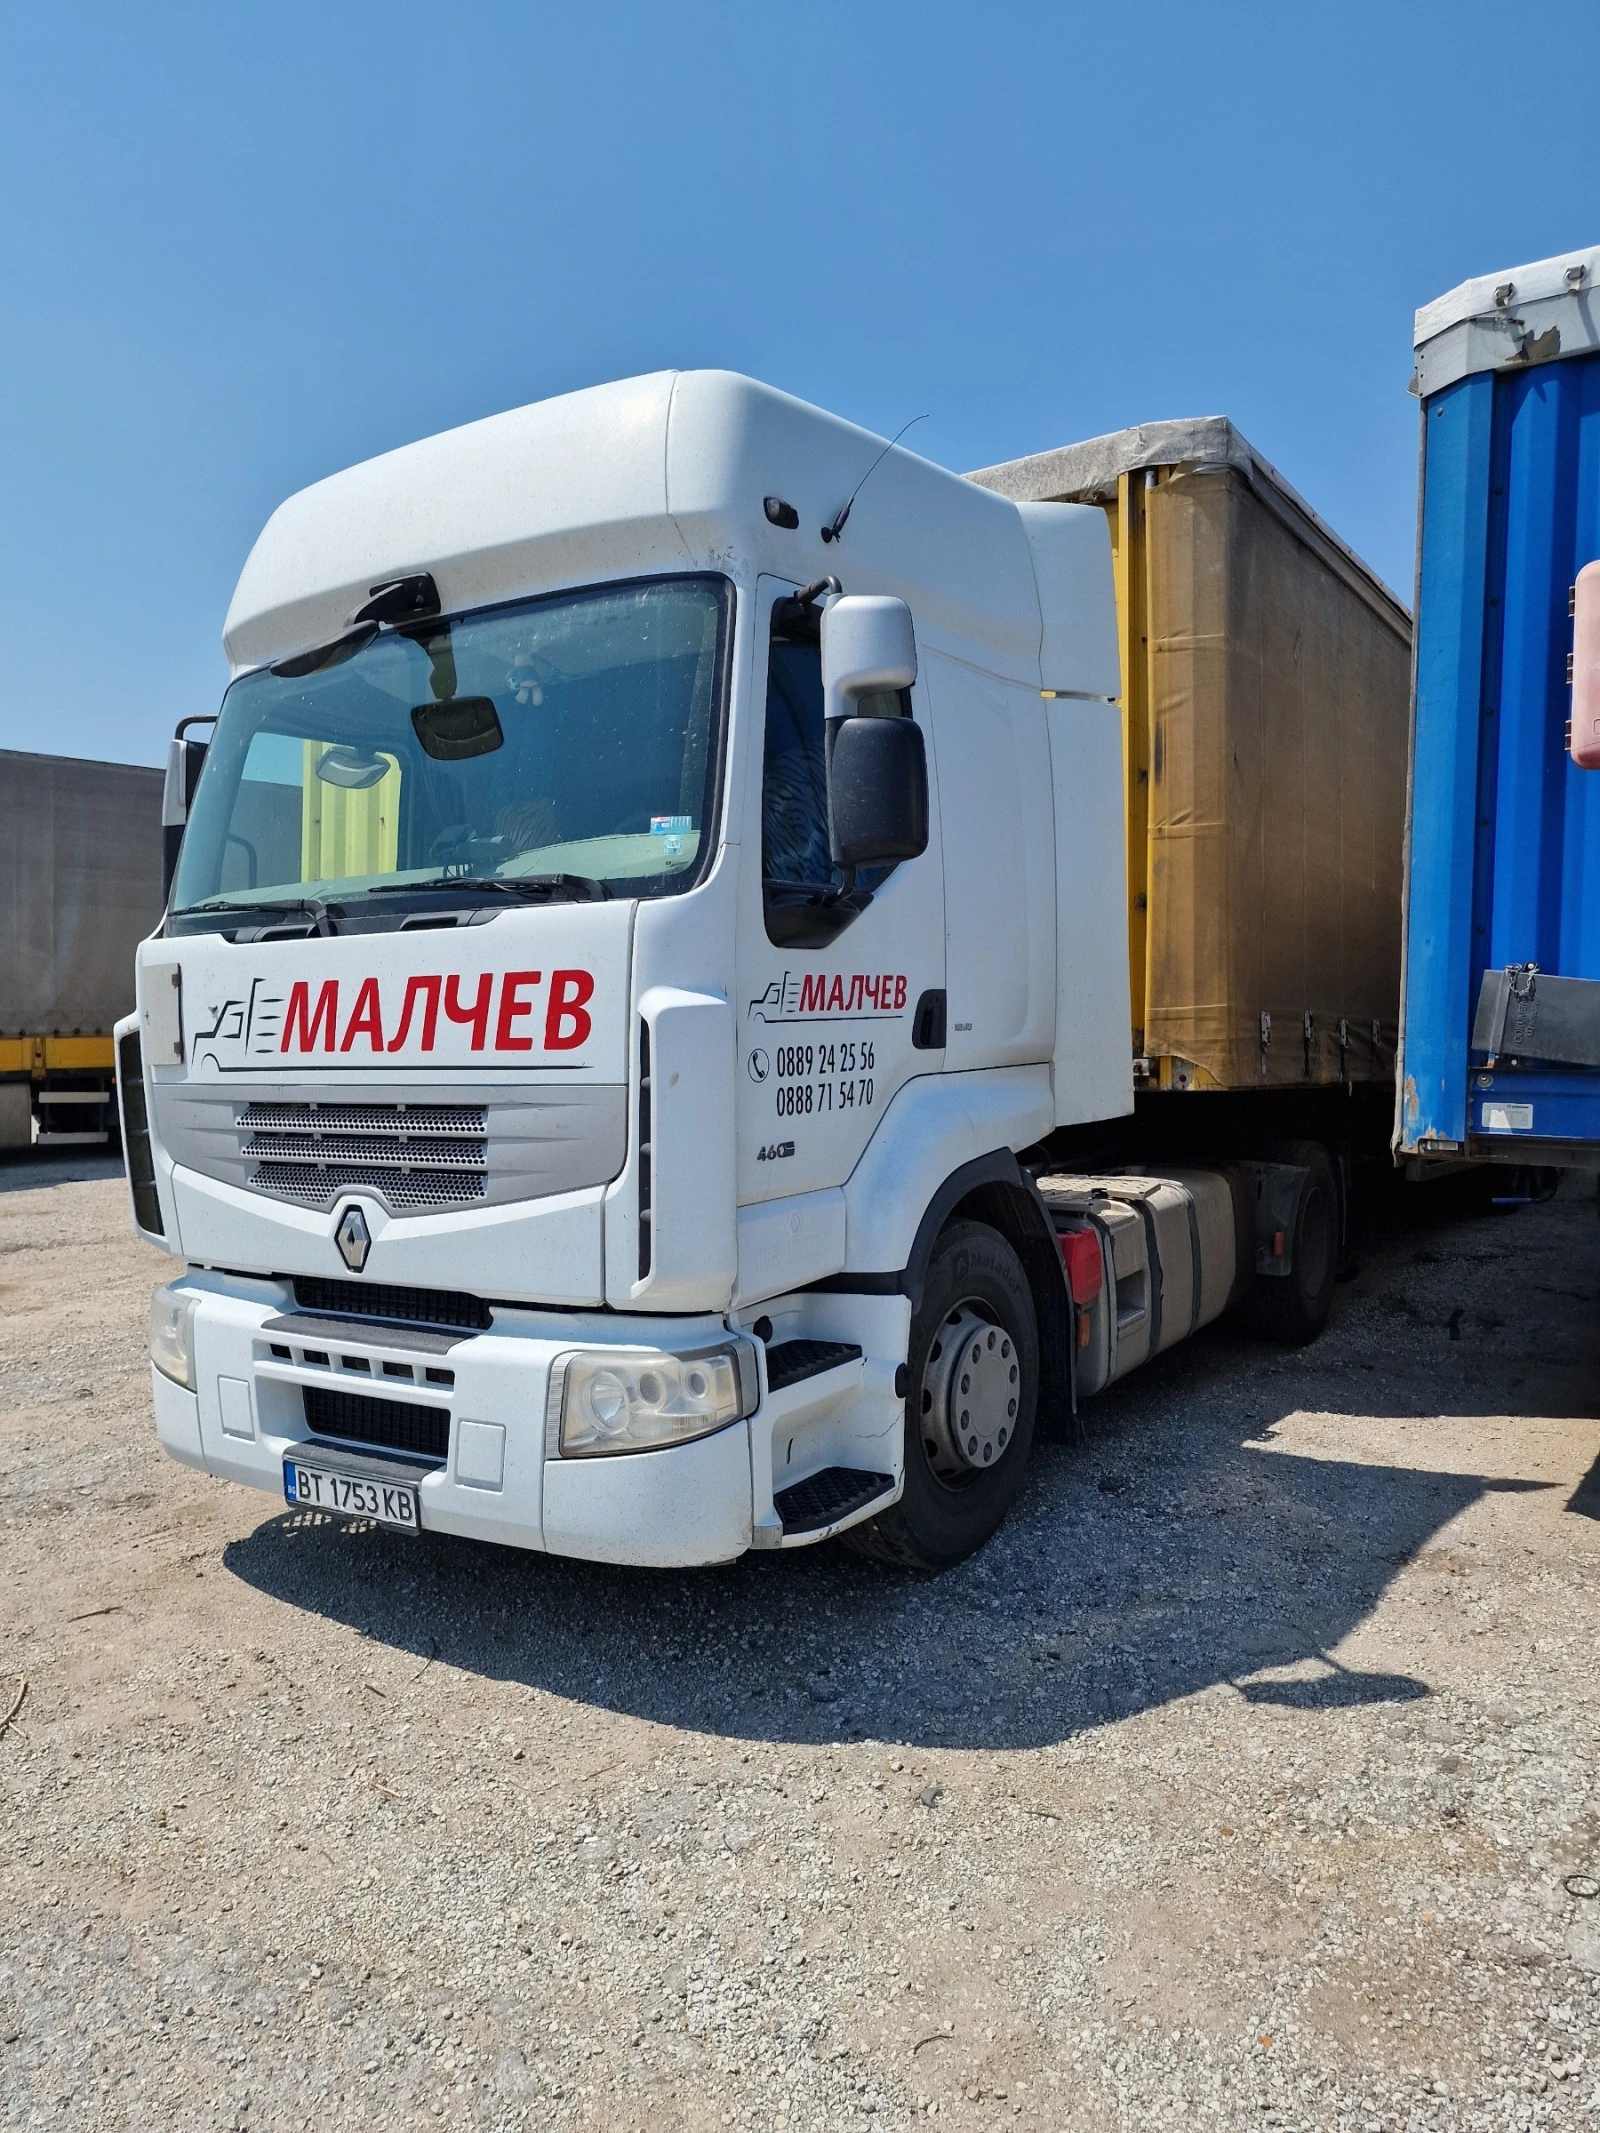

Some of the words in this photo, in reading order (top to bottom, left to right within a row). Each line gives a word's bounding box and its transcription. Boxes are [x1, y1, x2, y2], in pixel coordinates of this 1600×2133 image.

[281, 969, 595, 1053] МАЛЧЕВ
[799, 974, 908, 1012] МАЛЧЕВ
[777, 1045, 814, 1078] 0889
[818, 1044, 835, 1074] 24
[840, 1043, 856, 1072] 25
[860, 1041, 875, 1071] 56
[777, 1084, 813, 1117] 0888
[817, 1083, 832, 1112] 71
[839, 1080, 854, 1109] 54
[858, 1078, 874, 1107] 70
[330, 1478, 378, 1513] 1753
